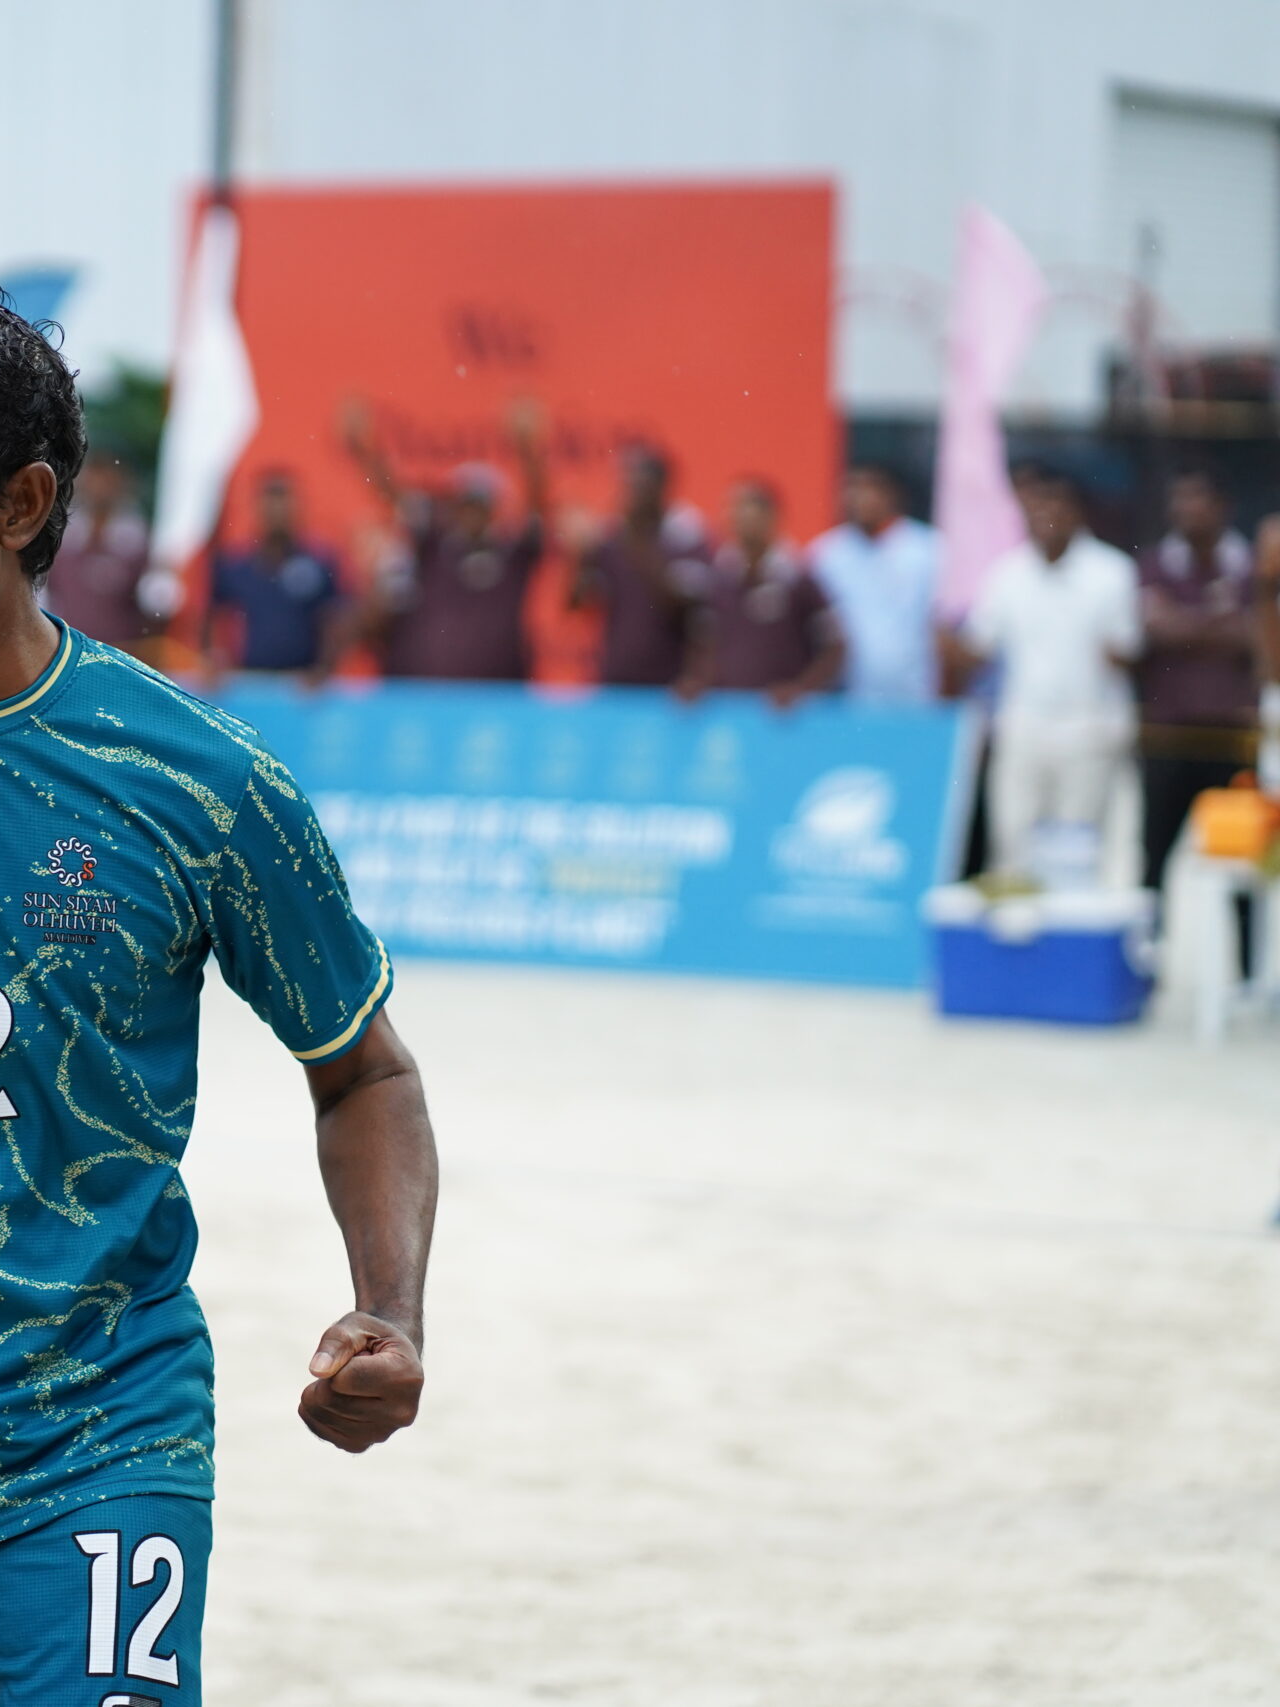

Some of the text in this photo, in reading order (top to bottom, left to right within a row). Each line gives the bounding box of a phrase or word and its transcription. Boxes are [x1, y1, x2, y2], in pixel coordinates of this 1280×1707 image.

[23, 892, 117, 914] SUN SIYAM
[23, 911, 117, 933] OLHUVELI
[43, 932, 97, 945] MALDIVES
[72, 1529, 184, 1688] 12
